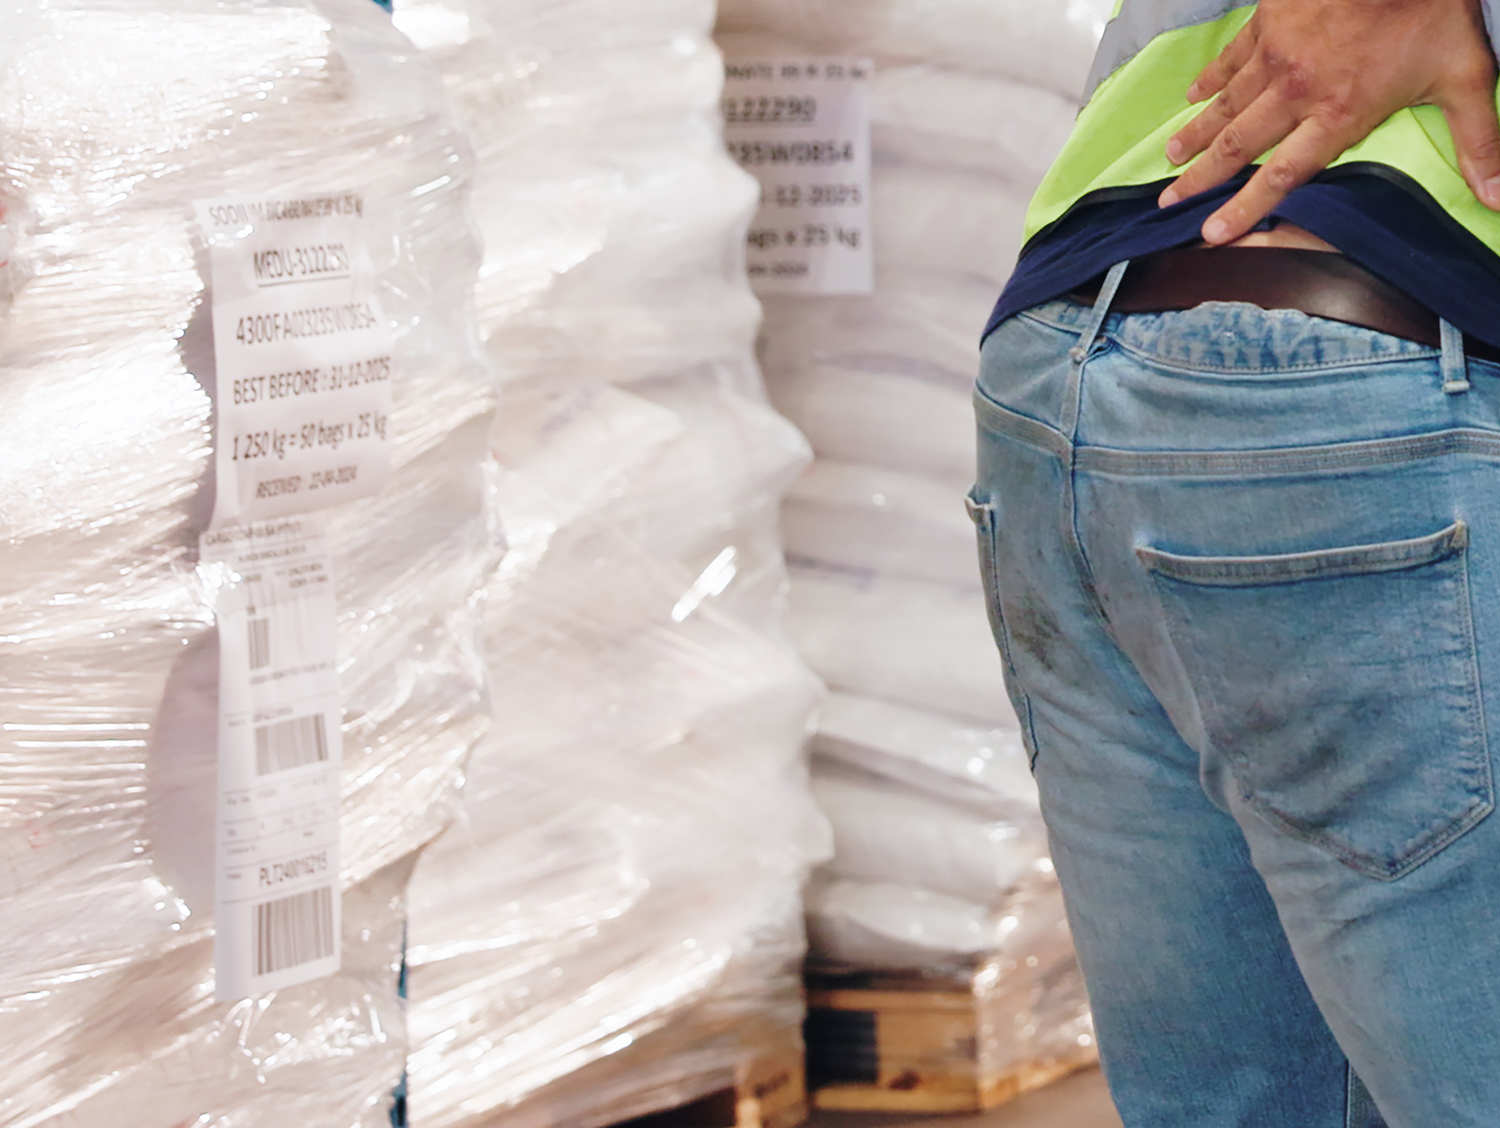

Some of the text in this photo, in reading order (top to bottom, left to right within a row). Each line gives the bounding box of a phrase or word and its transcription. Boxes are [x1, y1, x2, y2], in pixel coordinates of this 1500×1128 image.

[720, 95, 817, 122] 122290
[233, 375, 266, 405] BEST
[269, 368, 320, 400] BEFORE
[272, 427, 287, 460] kg
